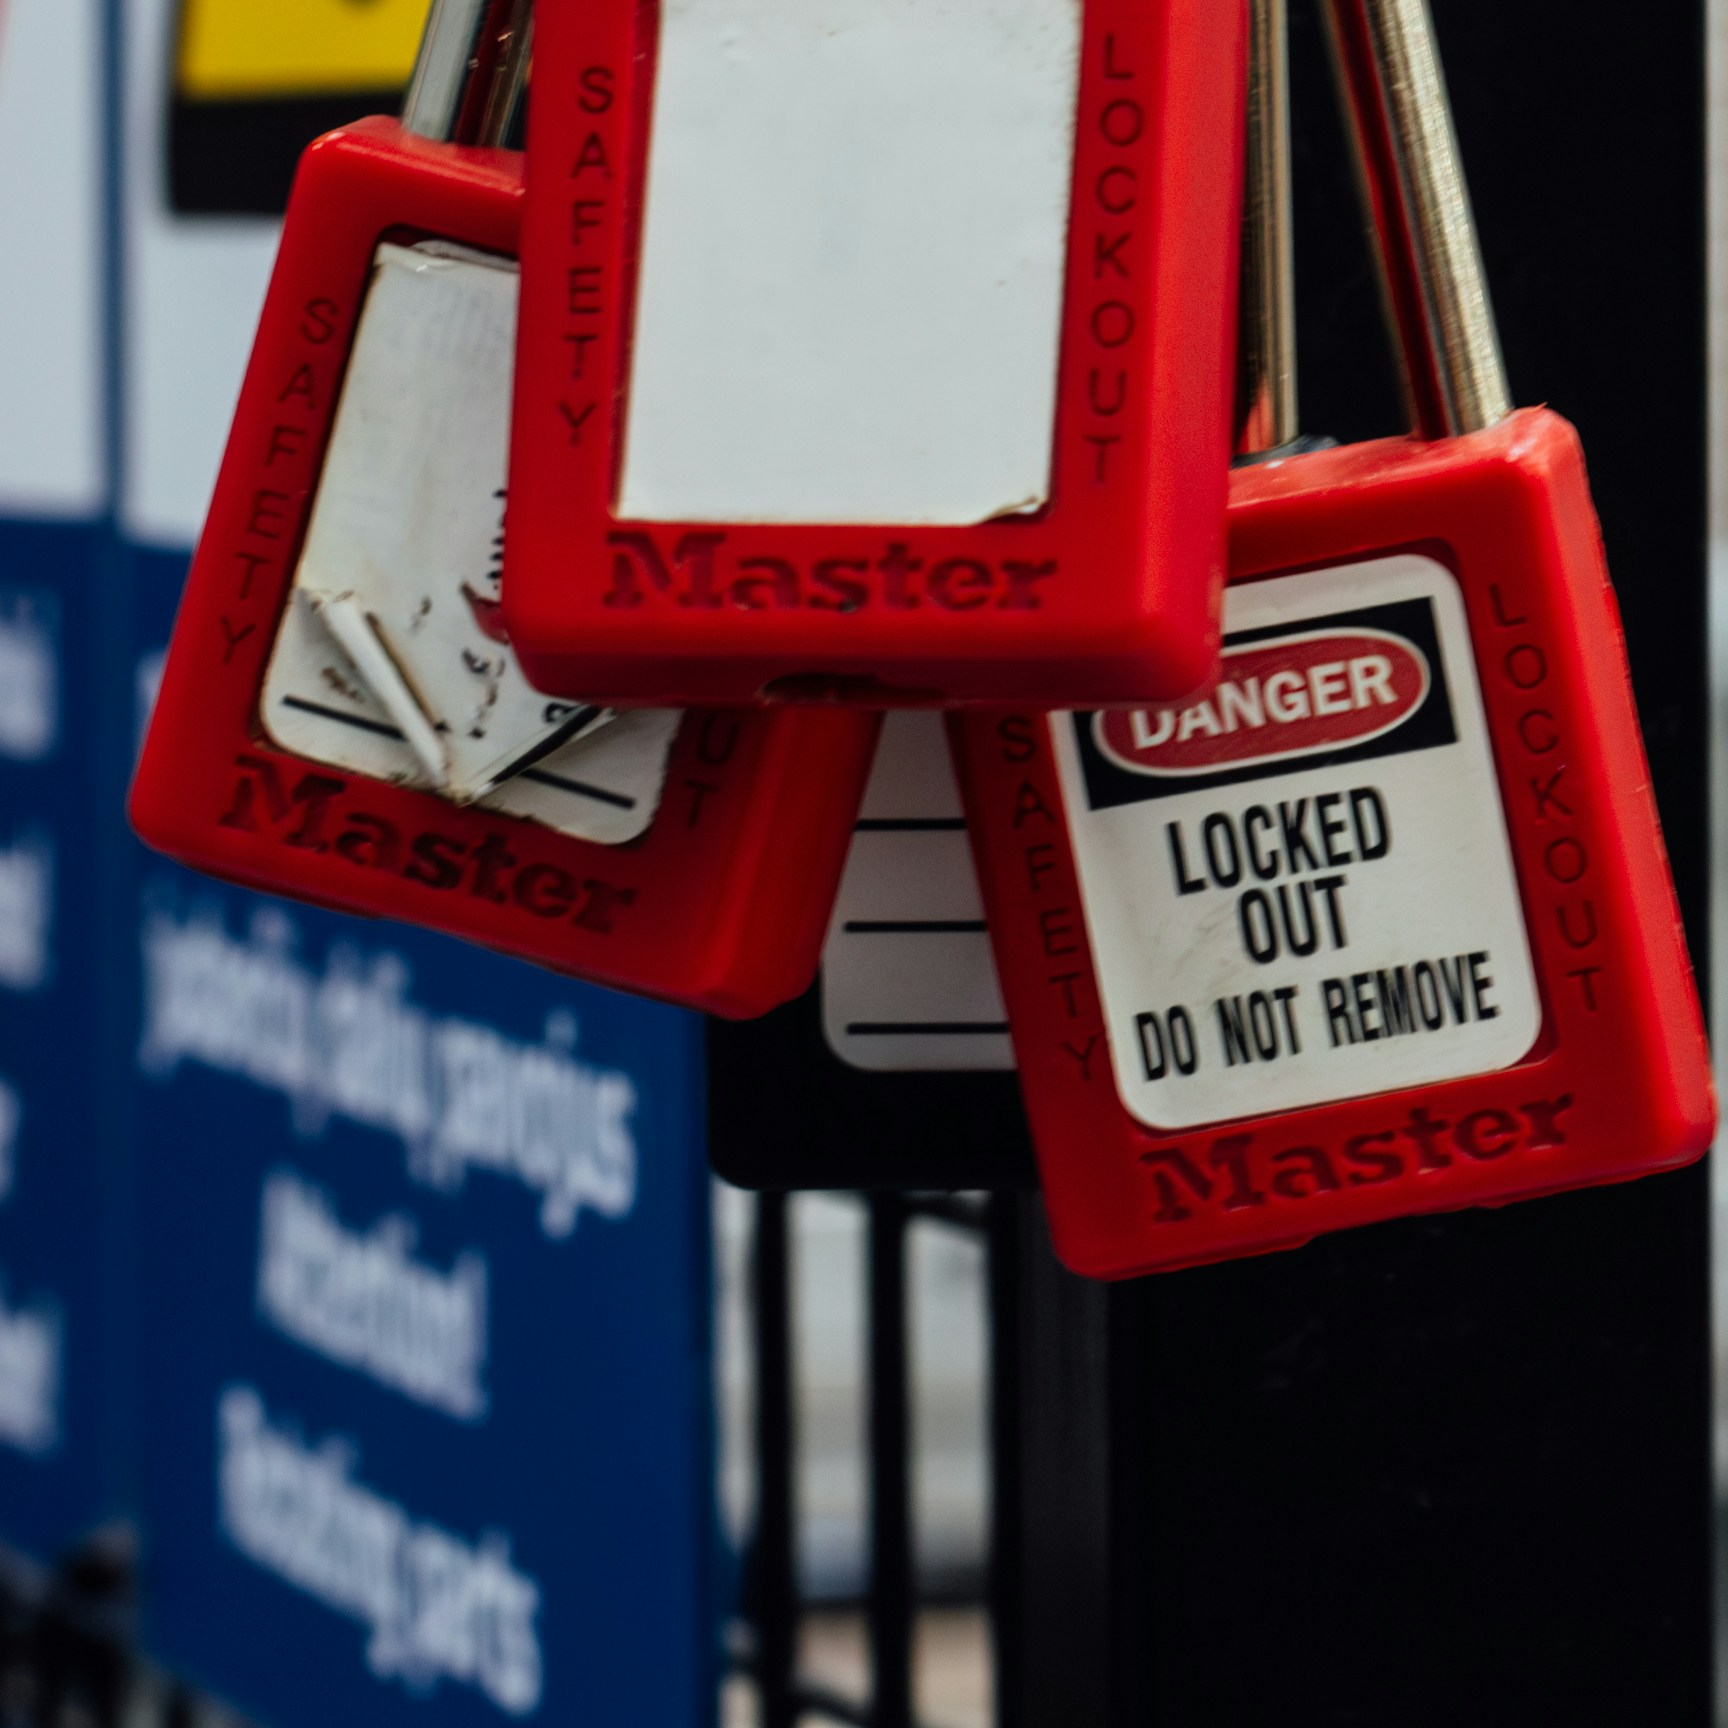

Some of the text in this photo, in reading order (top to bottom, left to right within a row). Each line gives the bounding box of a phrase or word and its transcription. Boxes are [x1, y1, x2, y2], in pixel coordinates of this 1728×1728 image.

[556, 66, 614, 449] SAFETY
[1078, 32, 1144, 485] LOCKOUT
[220, 294, 342, 670] SAFETY
[600, 530, 1059, 613] Master
[1130, 653, 1400, 751] DANGER
[217, 754, 640, 936] Master
[1166, 784, 1394, 898] LOCKED
[1486, 582, 1600, 1012] LOCKOUT
[997, 714, 1100, 1084] SAFETY
[1236, 874, 1350, 965] OUT
[1133, 949, 1502, 1083] DO NOT REMOVE
[1139, 1090, 1575, 1224] Master
